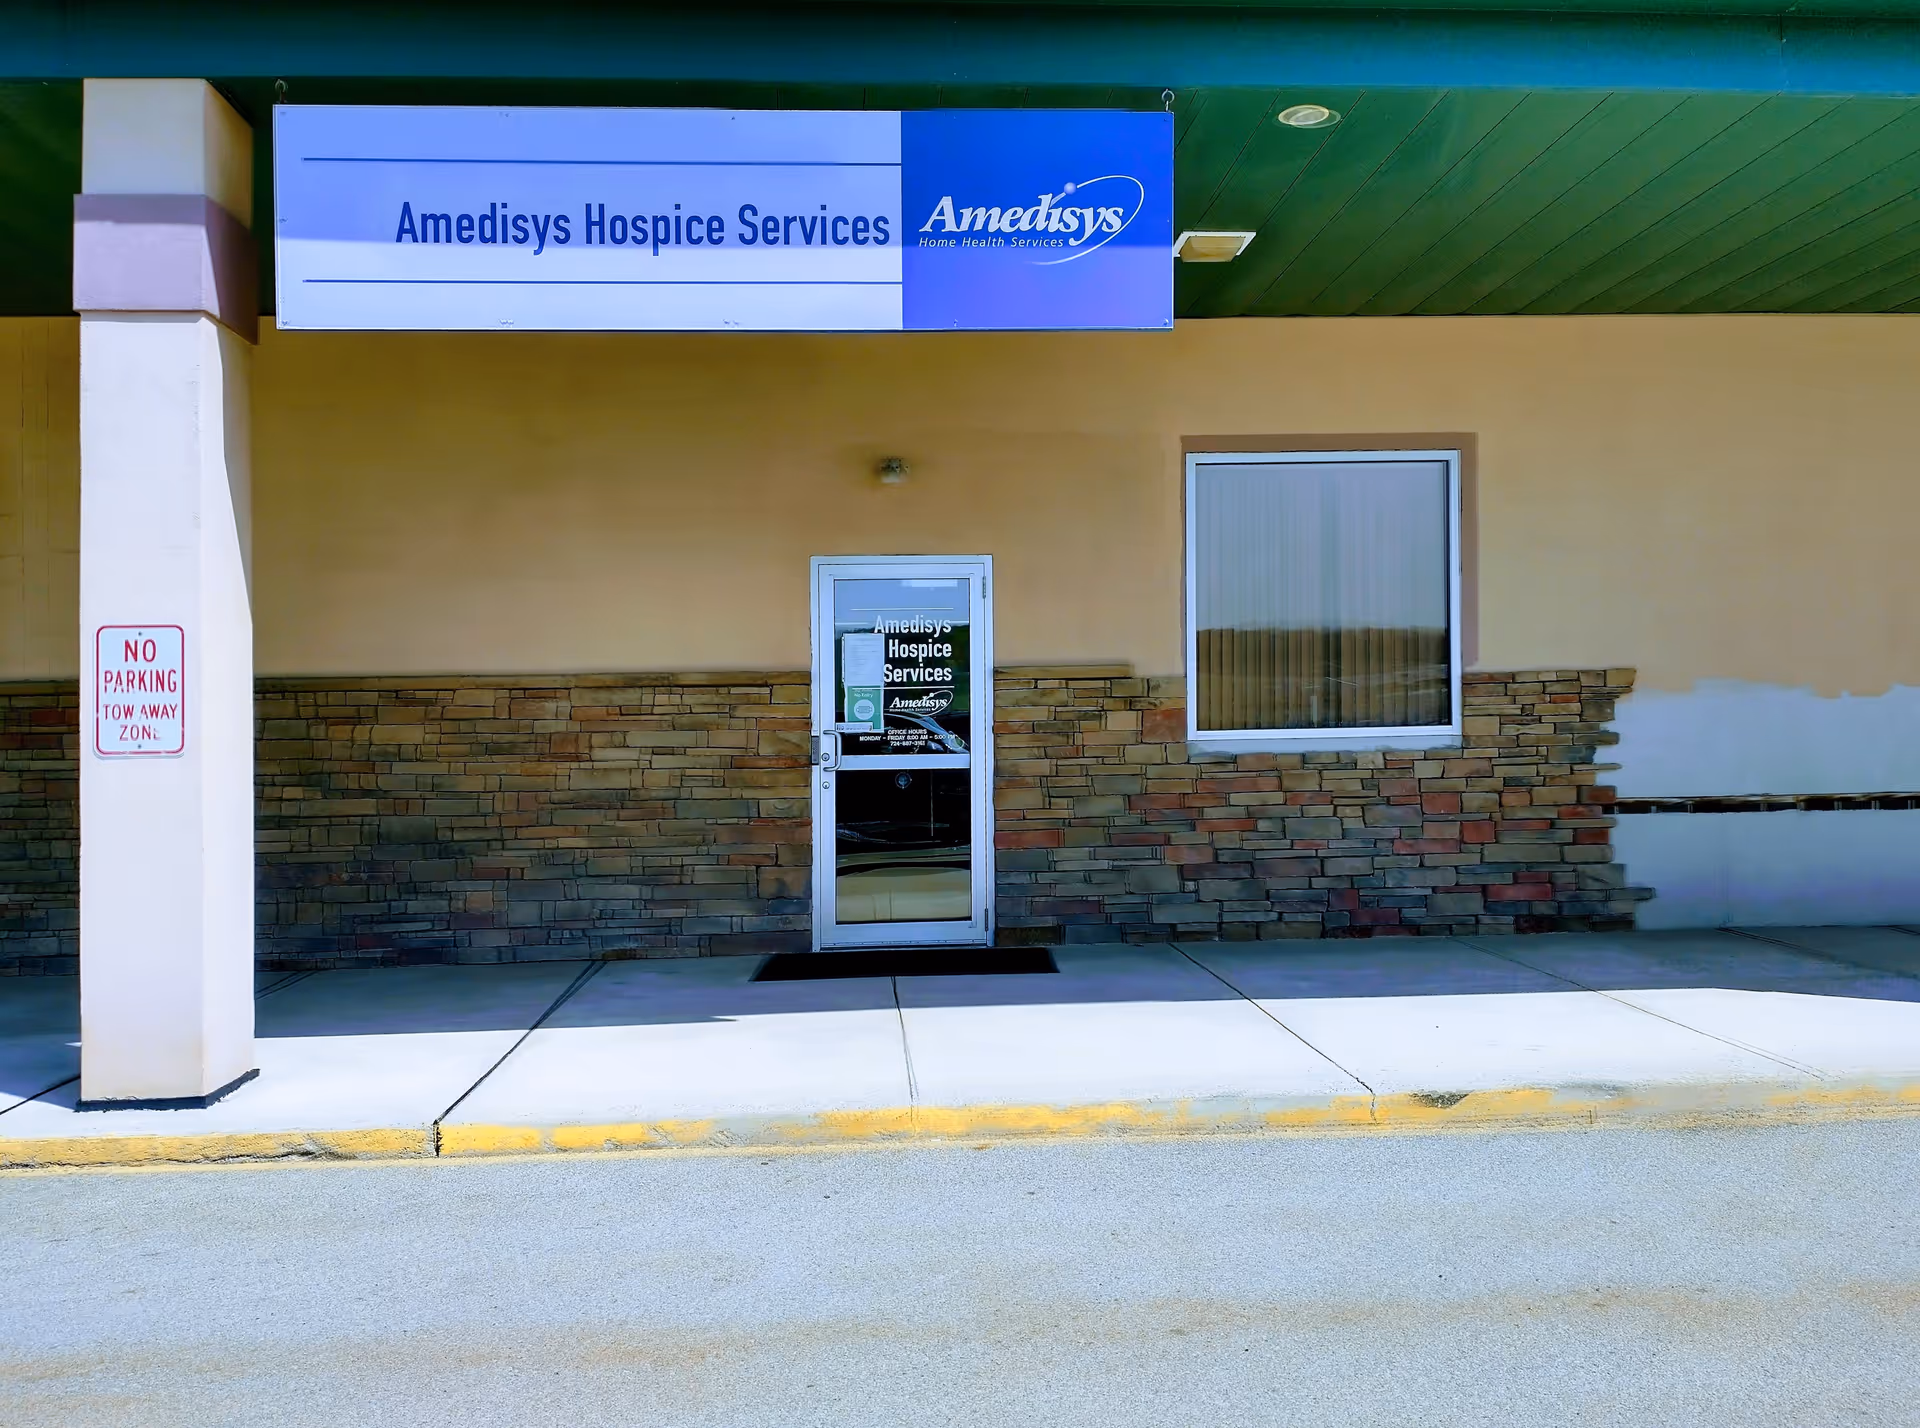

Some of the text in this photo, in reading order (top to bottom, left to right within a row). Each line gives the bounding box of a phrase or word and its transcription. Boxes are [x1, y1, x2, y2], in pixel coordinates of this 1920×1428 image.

[395, 201, 890, 256] Amedisys Hospice Services
[919, 193, 1124, 247] Amedisys
[918, 236, 1064, 248] Home Health Services
[874, 615, 952, 638] Amedisys
[124, 638, 157, 663] NO
[888, 639, 952, 662] Hospice
[104, 668, 177, 693] PARKING
[883, 663, 953, 683] Services
[103, 703, 178, 721] TOW AWAY
[889, 696, 948, 711] Amedisys
